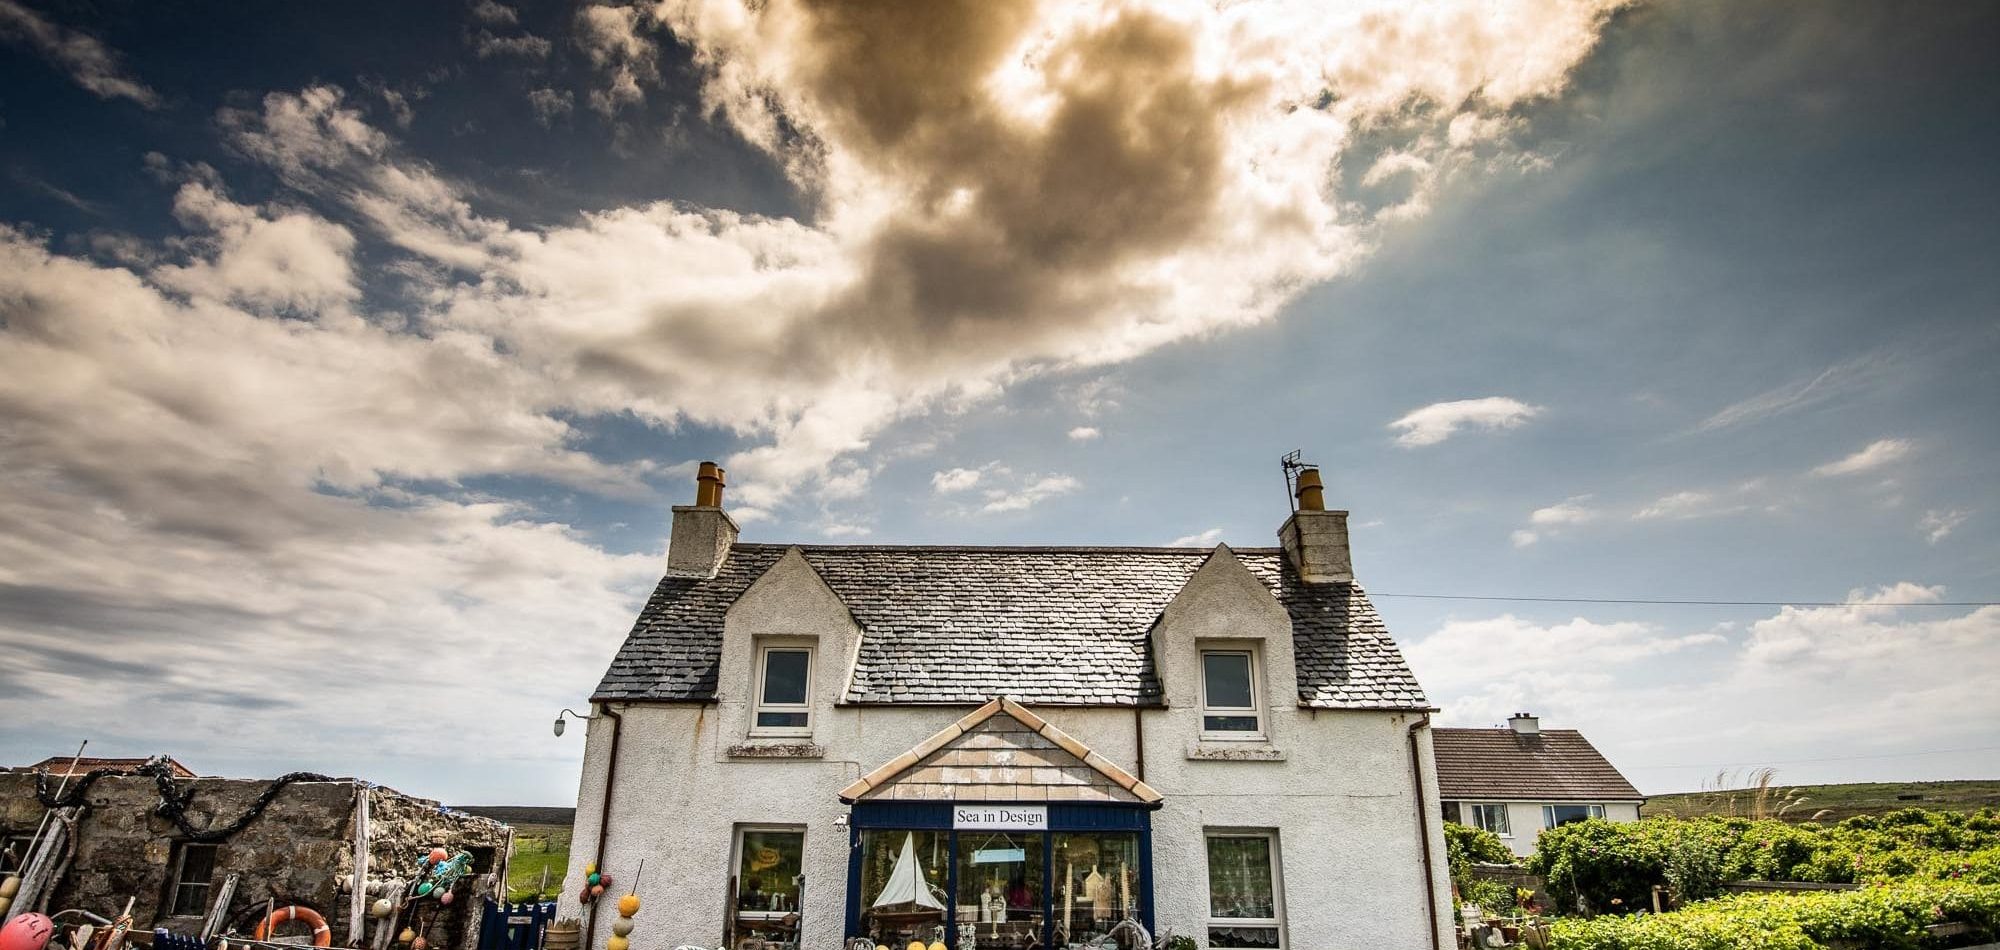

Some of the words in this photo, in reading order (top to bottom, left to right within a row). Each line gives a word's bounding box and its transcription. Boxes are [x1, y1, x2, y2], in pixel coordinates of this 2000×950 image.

[957, 809, 980, 823] Sea
[984, 809, 995, 823] in
[1000, 809, 1043, 826] Design
